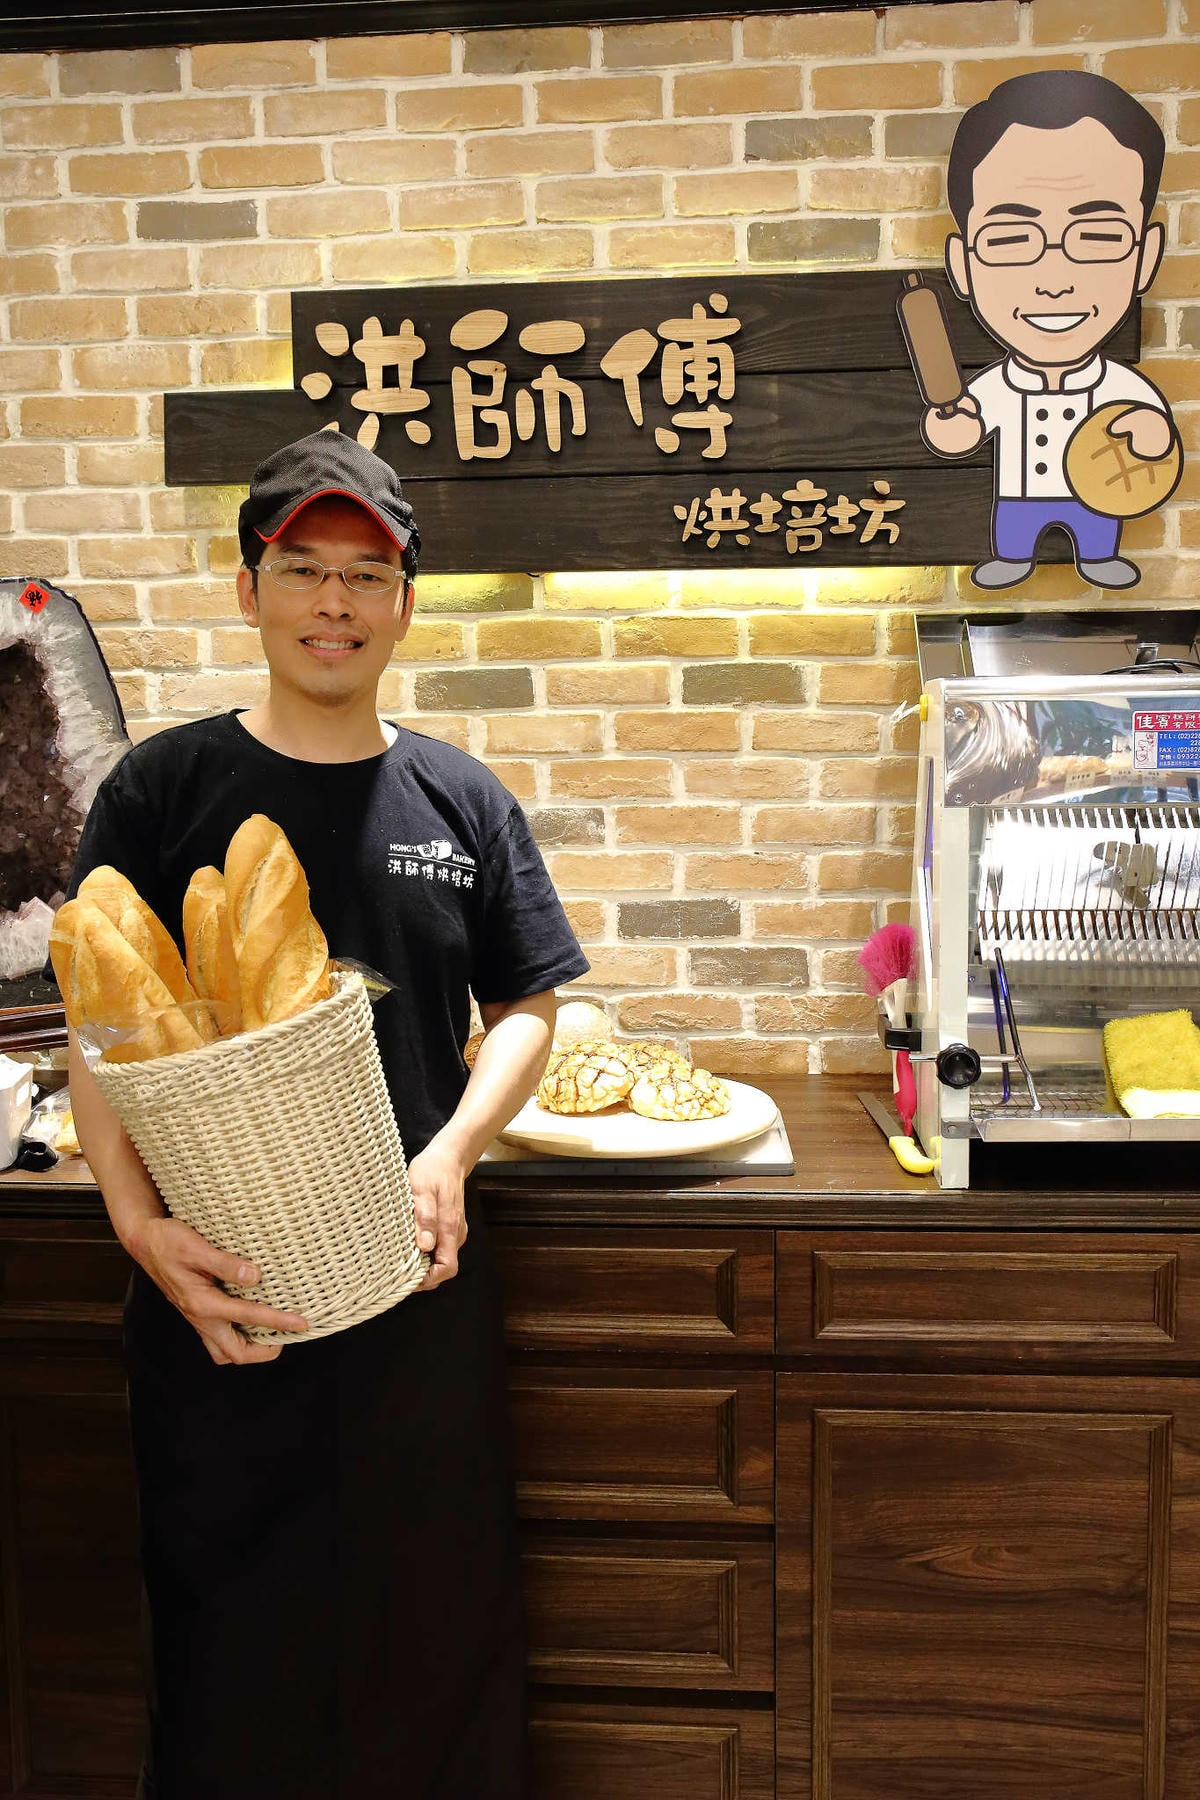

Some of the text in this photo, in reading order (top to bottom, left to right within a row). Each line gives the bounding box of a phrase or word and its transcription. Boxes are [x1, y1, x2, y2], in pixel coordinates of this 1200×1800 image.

[301, 292, 742, 461] 洪師傅
[452, 853, 475, 866] BAKERY
